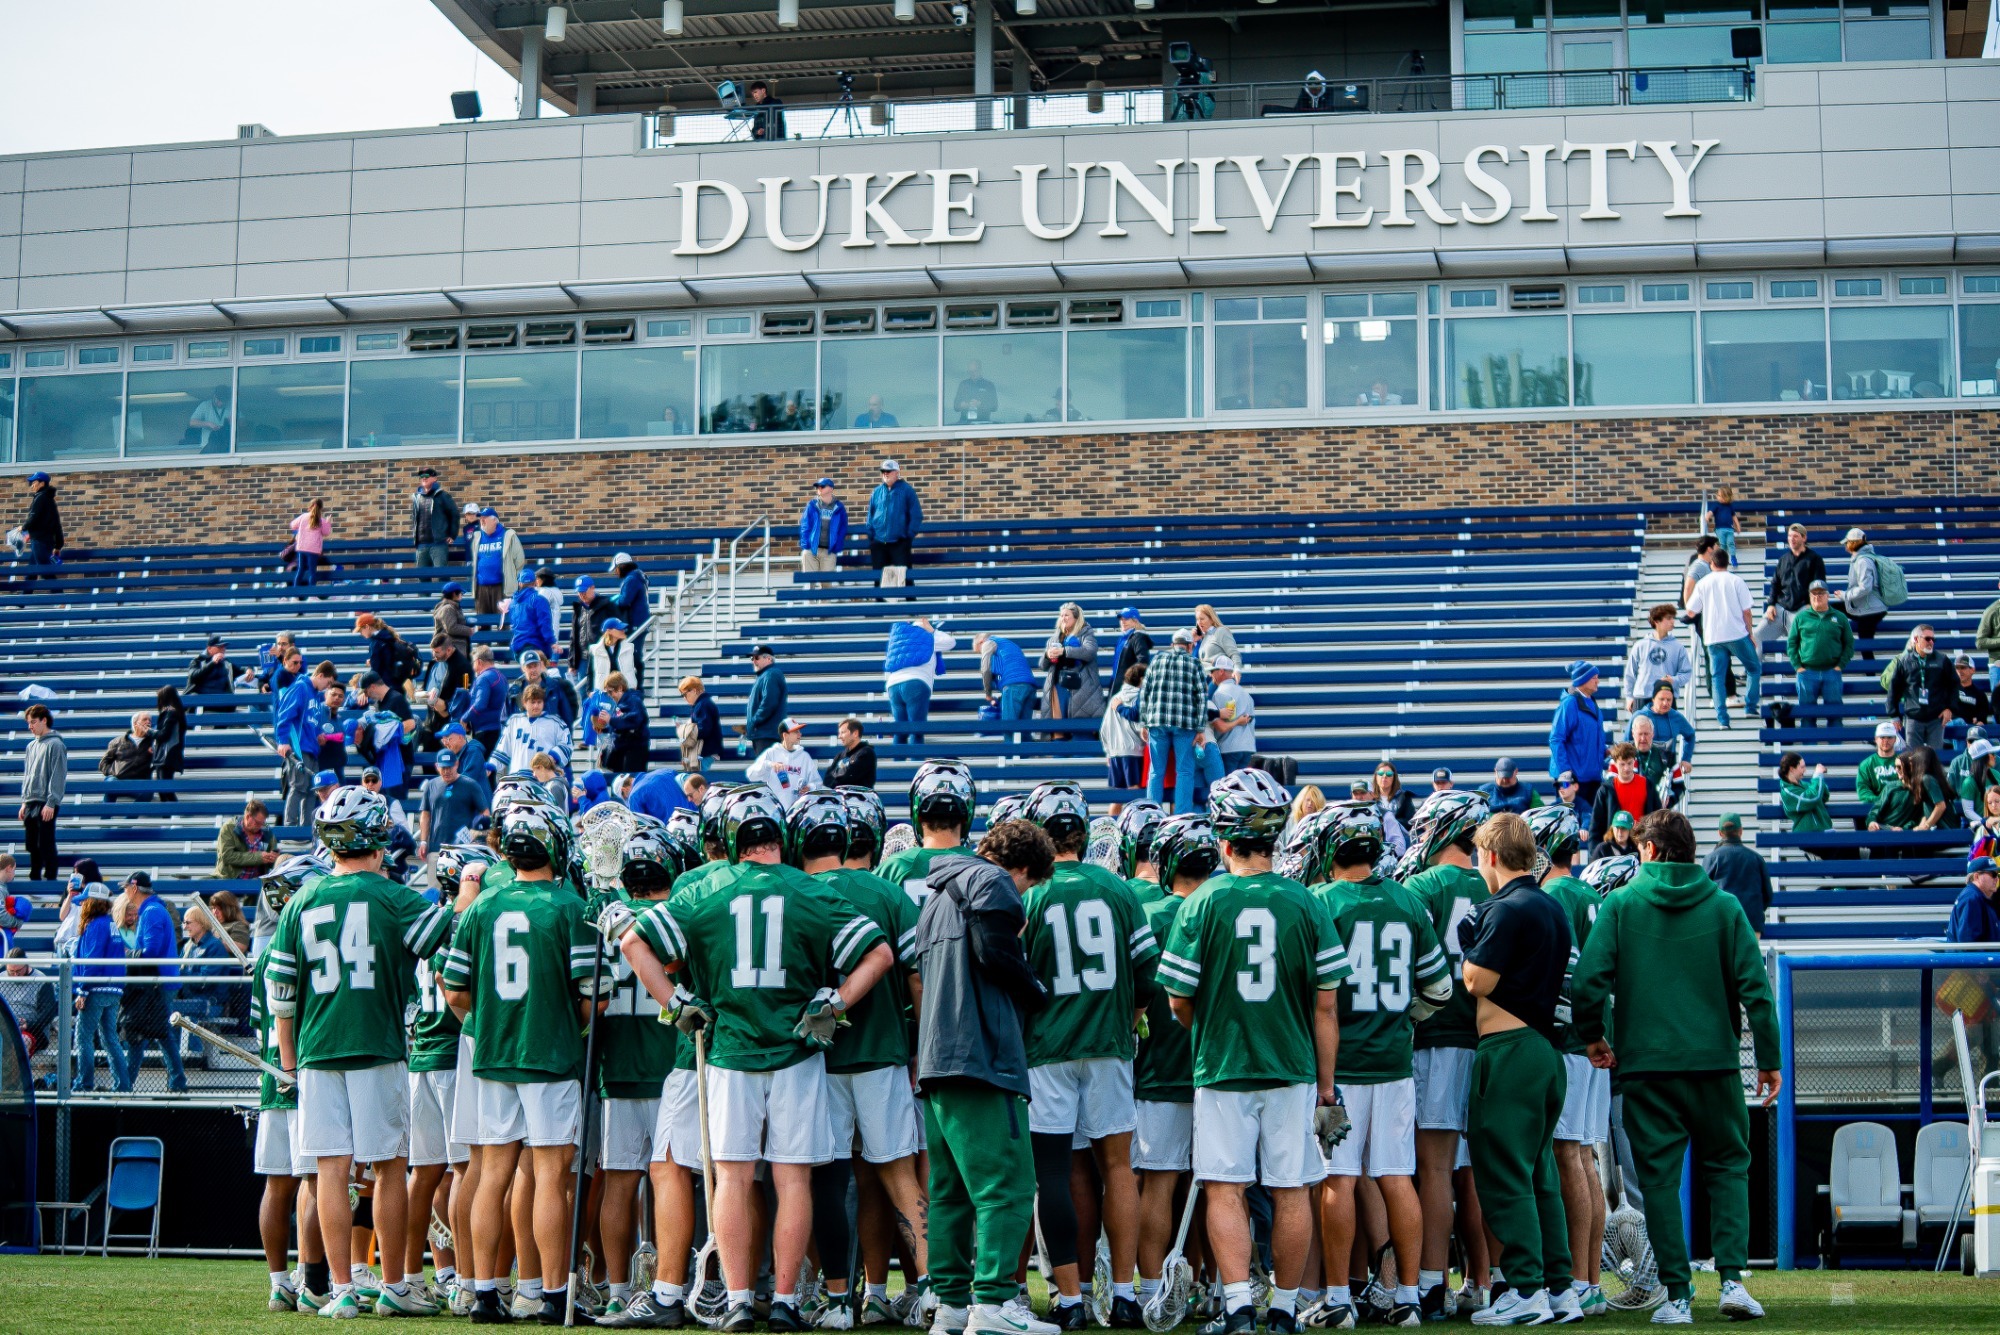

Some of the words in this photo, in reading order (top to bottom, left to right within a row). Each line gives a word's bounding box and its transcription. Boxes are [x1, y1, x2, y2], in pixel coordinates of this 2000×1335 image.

[672, 165, 986, 257] DUKE
[1013, 138, 1721, 241] UNIVERSITY
[479, 541, 502, 552] DUKE
[300, 901, 376, 995] 54
[493, 910, 530, 1001] 6
[729, 894, 787, 989] 11
[1044, 898, 1117, 996] 19
[1235, 907, 1277, 1002] 3
[1346, 921, 1412, 1012] 43
